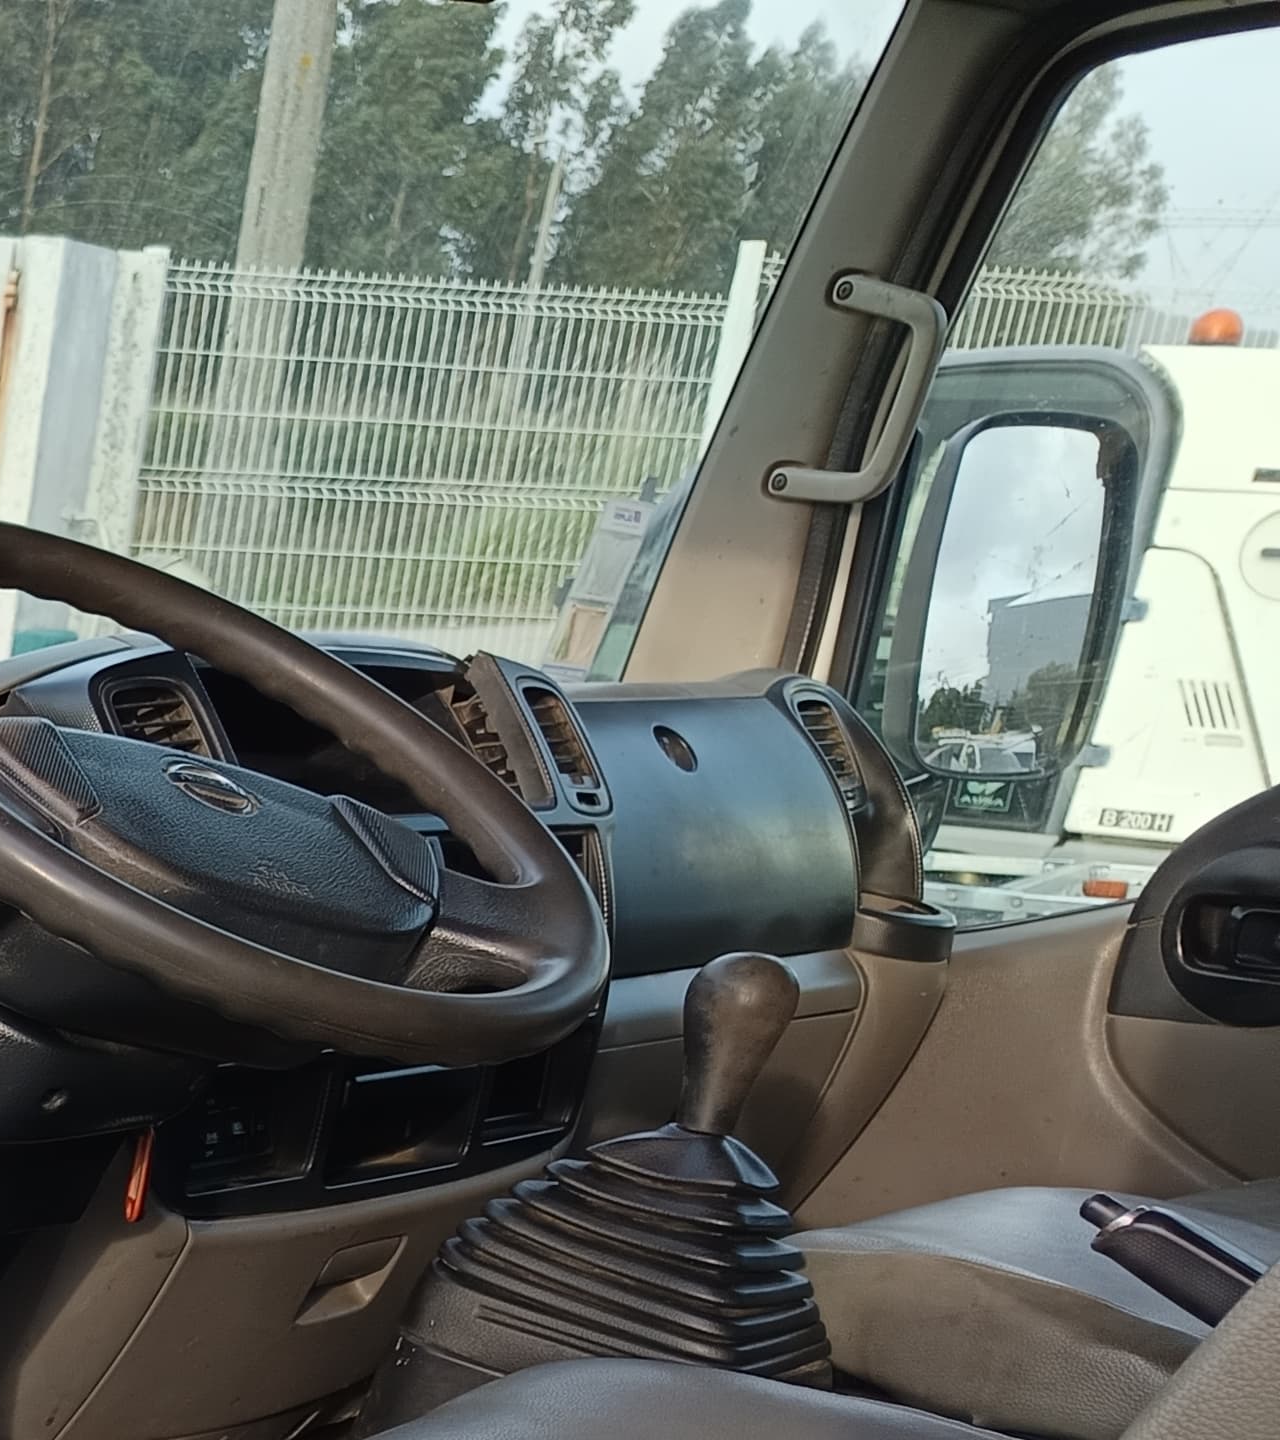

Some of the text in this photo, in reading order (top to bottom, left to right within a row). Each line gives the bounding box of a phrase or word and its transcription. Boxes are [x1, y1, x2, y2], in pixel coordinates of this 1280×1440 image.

[1102, 809, 1171, 832] B 200 H
